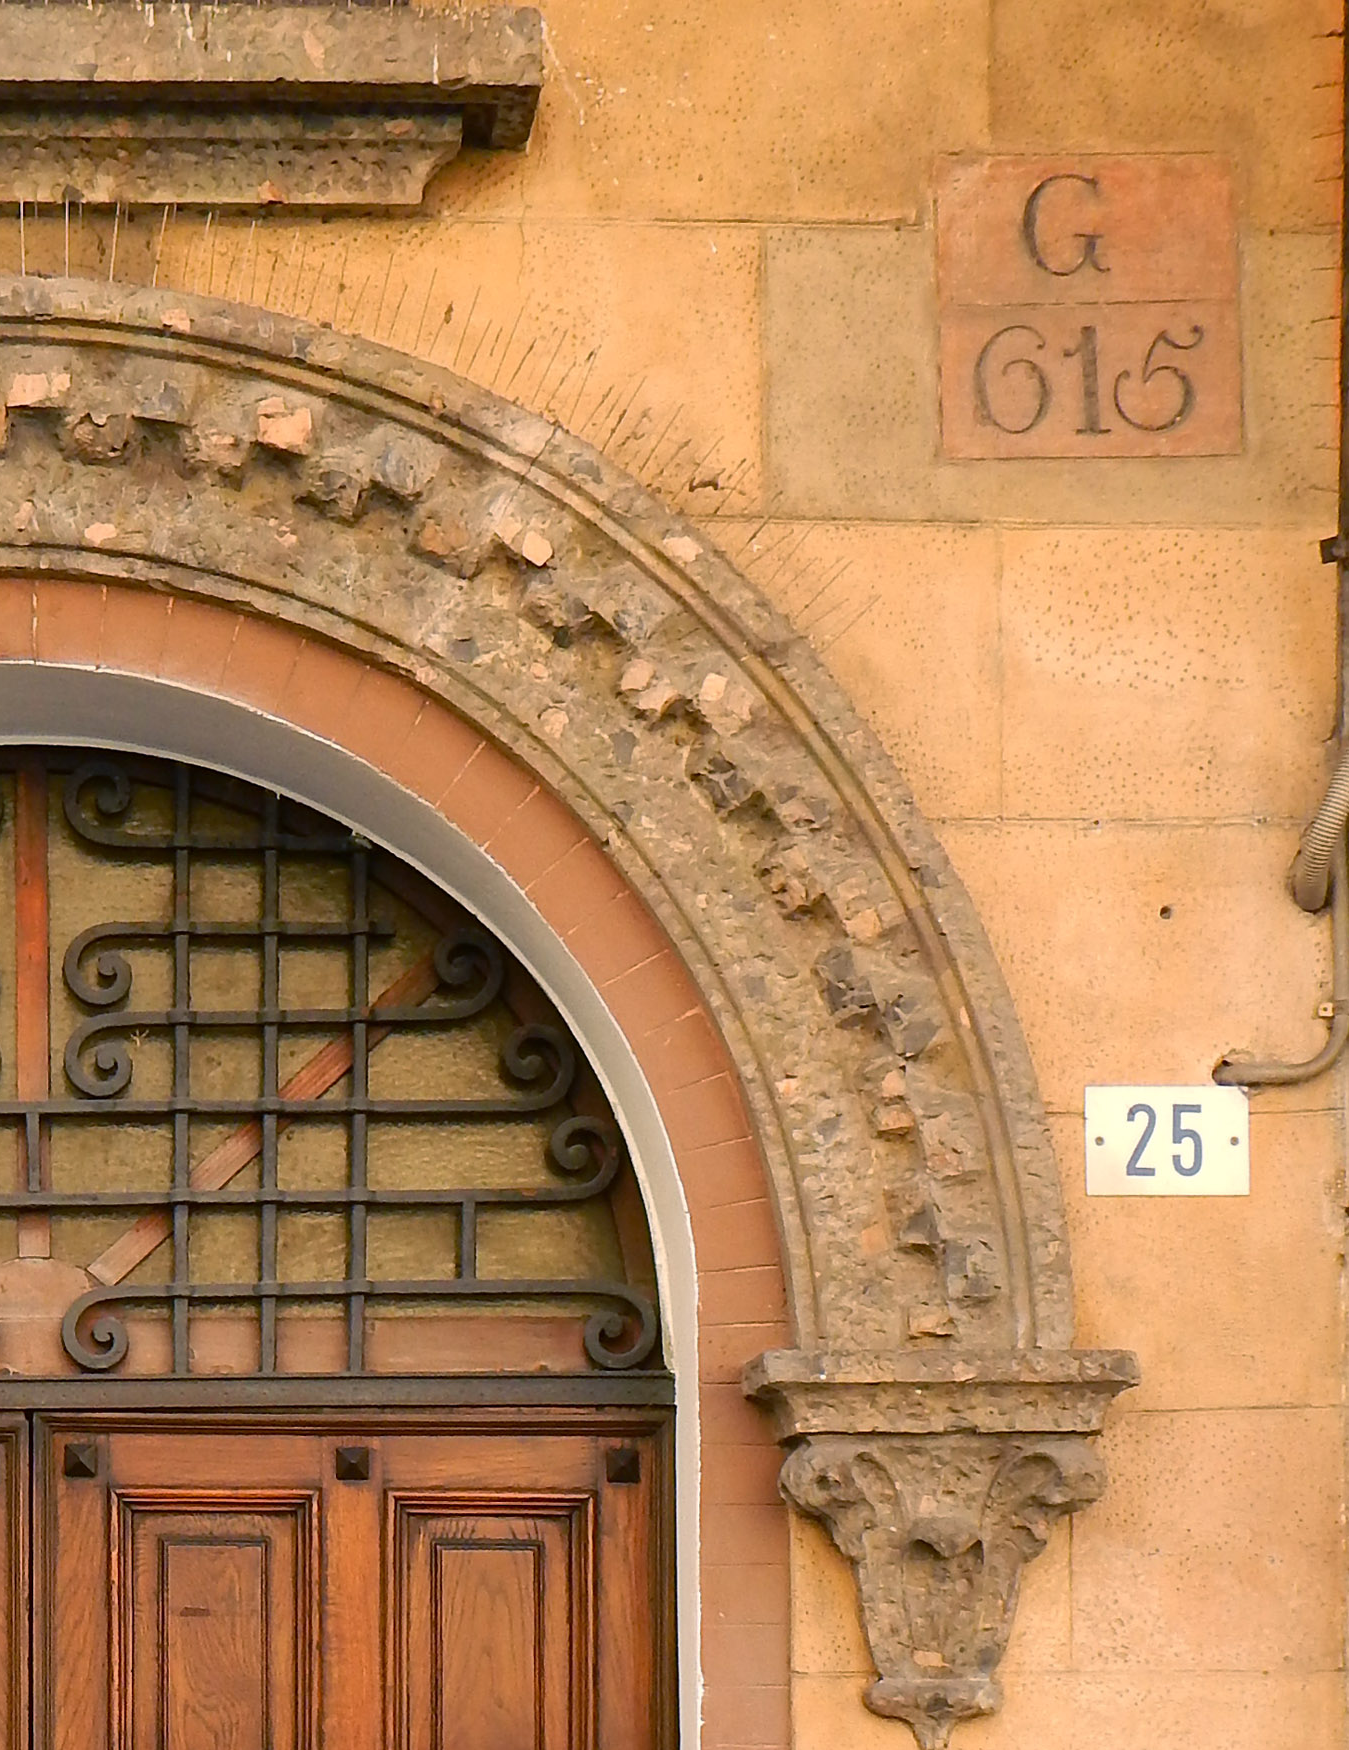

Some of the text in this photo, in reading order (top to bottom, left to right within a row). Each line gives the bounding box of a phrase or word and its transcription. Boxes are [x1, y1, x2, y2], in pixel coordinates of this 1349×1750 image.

[1023, 173, 1111, 277] G
[973, 324, 1204, 435] 615
[1126, 1103, 1203, 1177] 25
